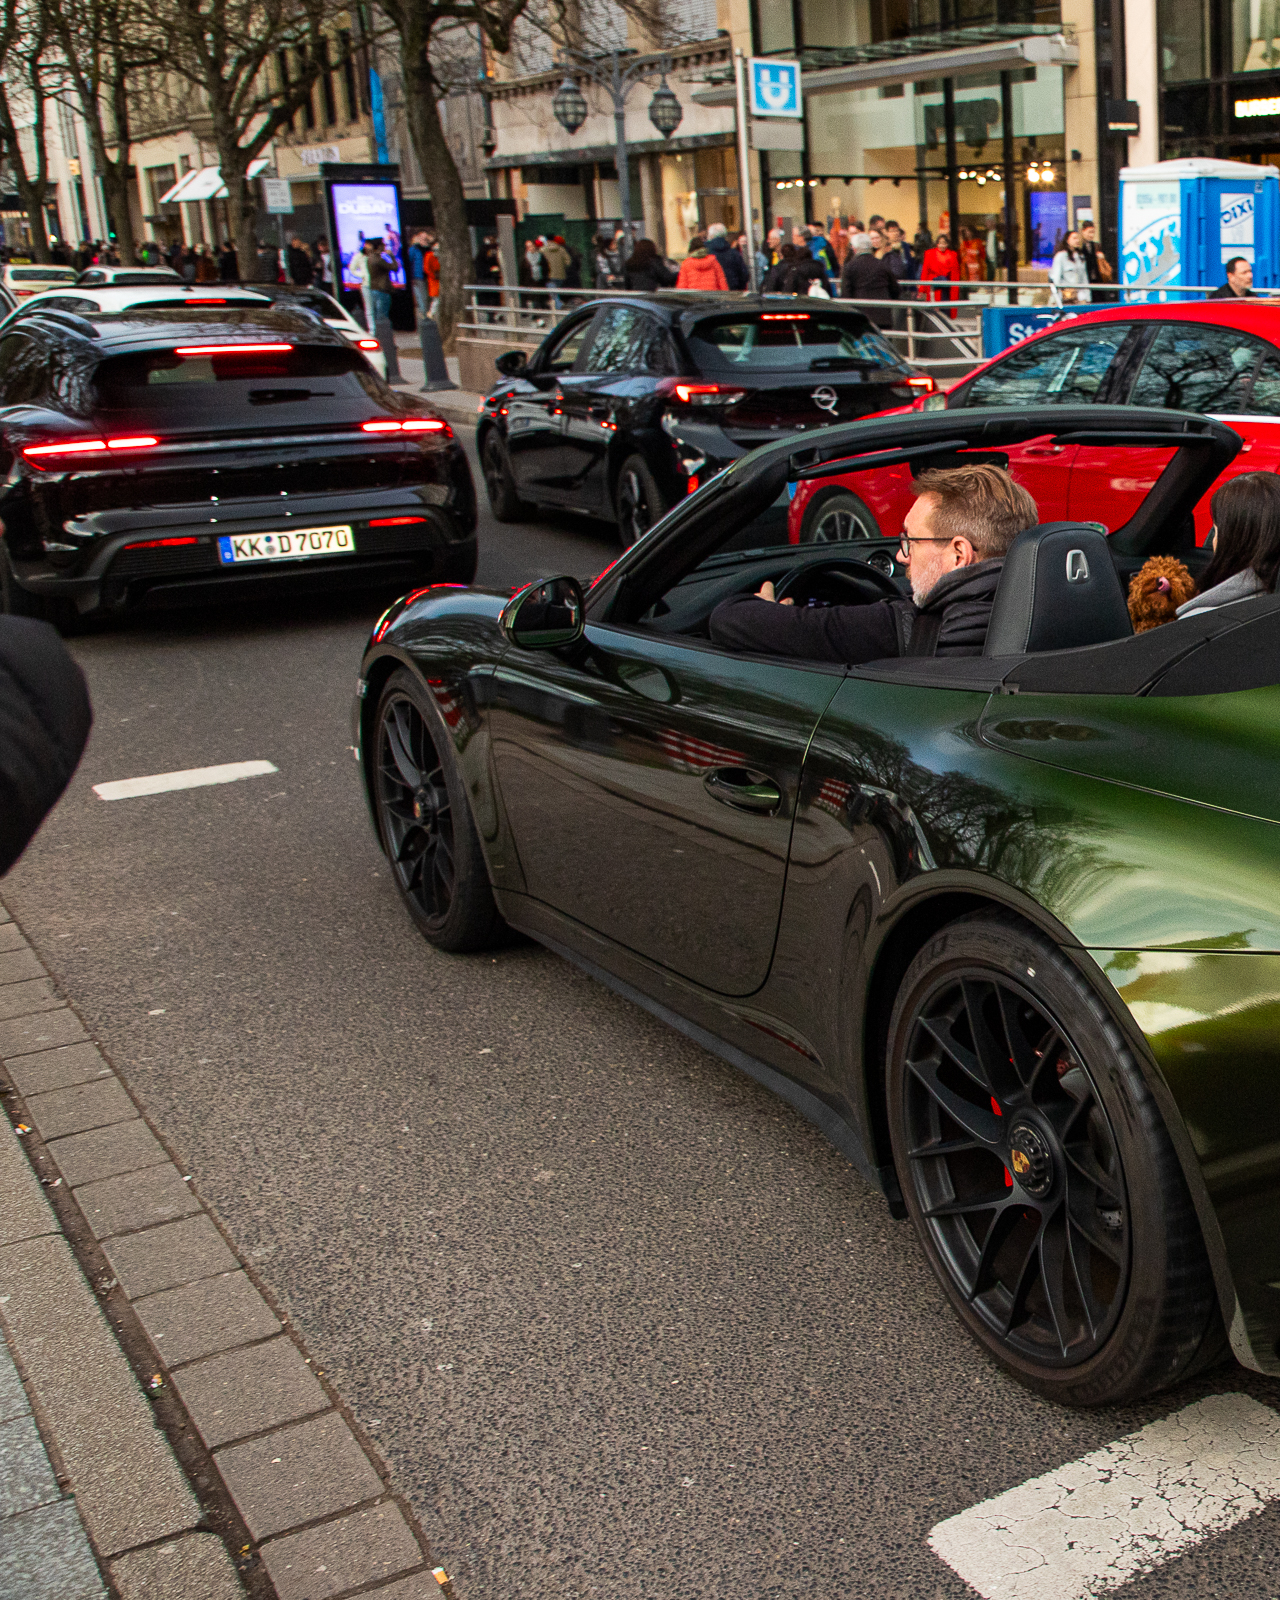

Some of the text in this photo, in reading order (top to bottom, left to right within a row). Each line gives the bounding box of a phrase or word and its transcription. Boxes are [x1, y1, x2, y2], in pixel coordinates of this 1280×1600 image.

[233, 529, 348, 558] KK D 7070
